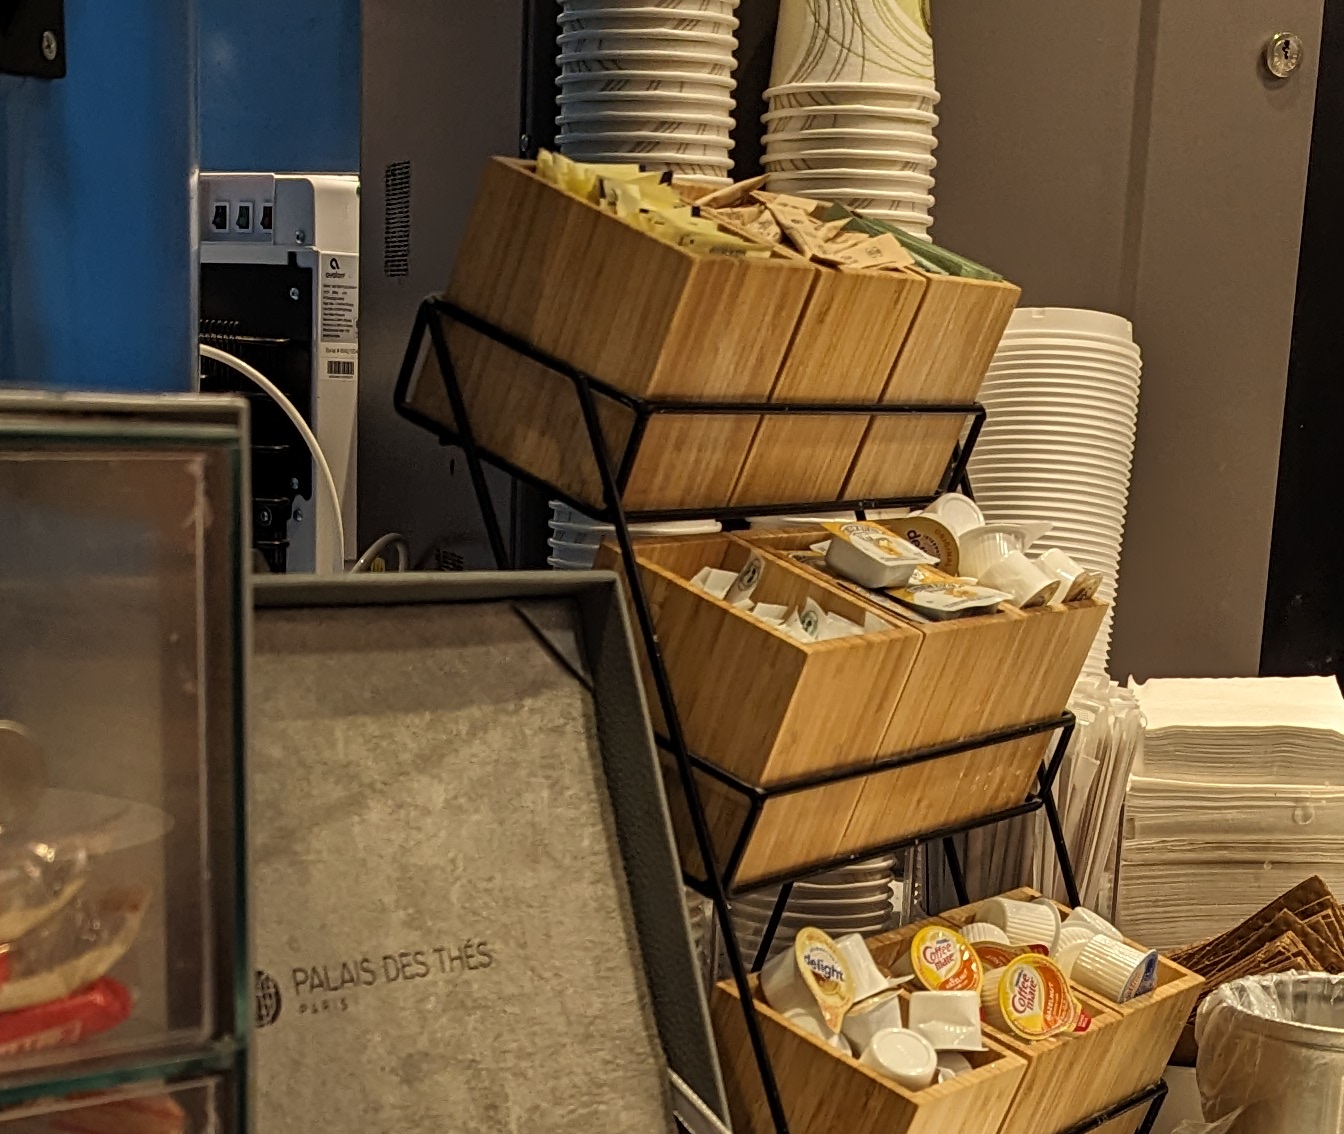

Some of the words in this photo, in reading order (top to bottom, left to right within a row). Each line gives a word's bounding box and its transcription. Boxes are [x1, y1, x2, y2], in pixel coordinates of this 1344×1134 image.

[291, 957, 377, 996] PALAIS
[382, 951, 430, 984] DES
[432, 938, 493, 974] THÉS
[804, 954, 845, 982] delight
[922, 942, 952, 965] Coffee
[1011, 972, 1030, 1014] Coffee
